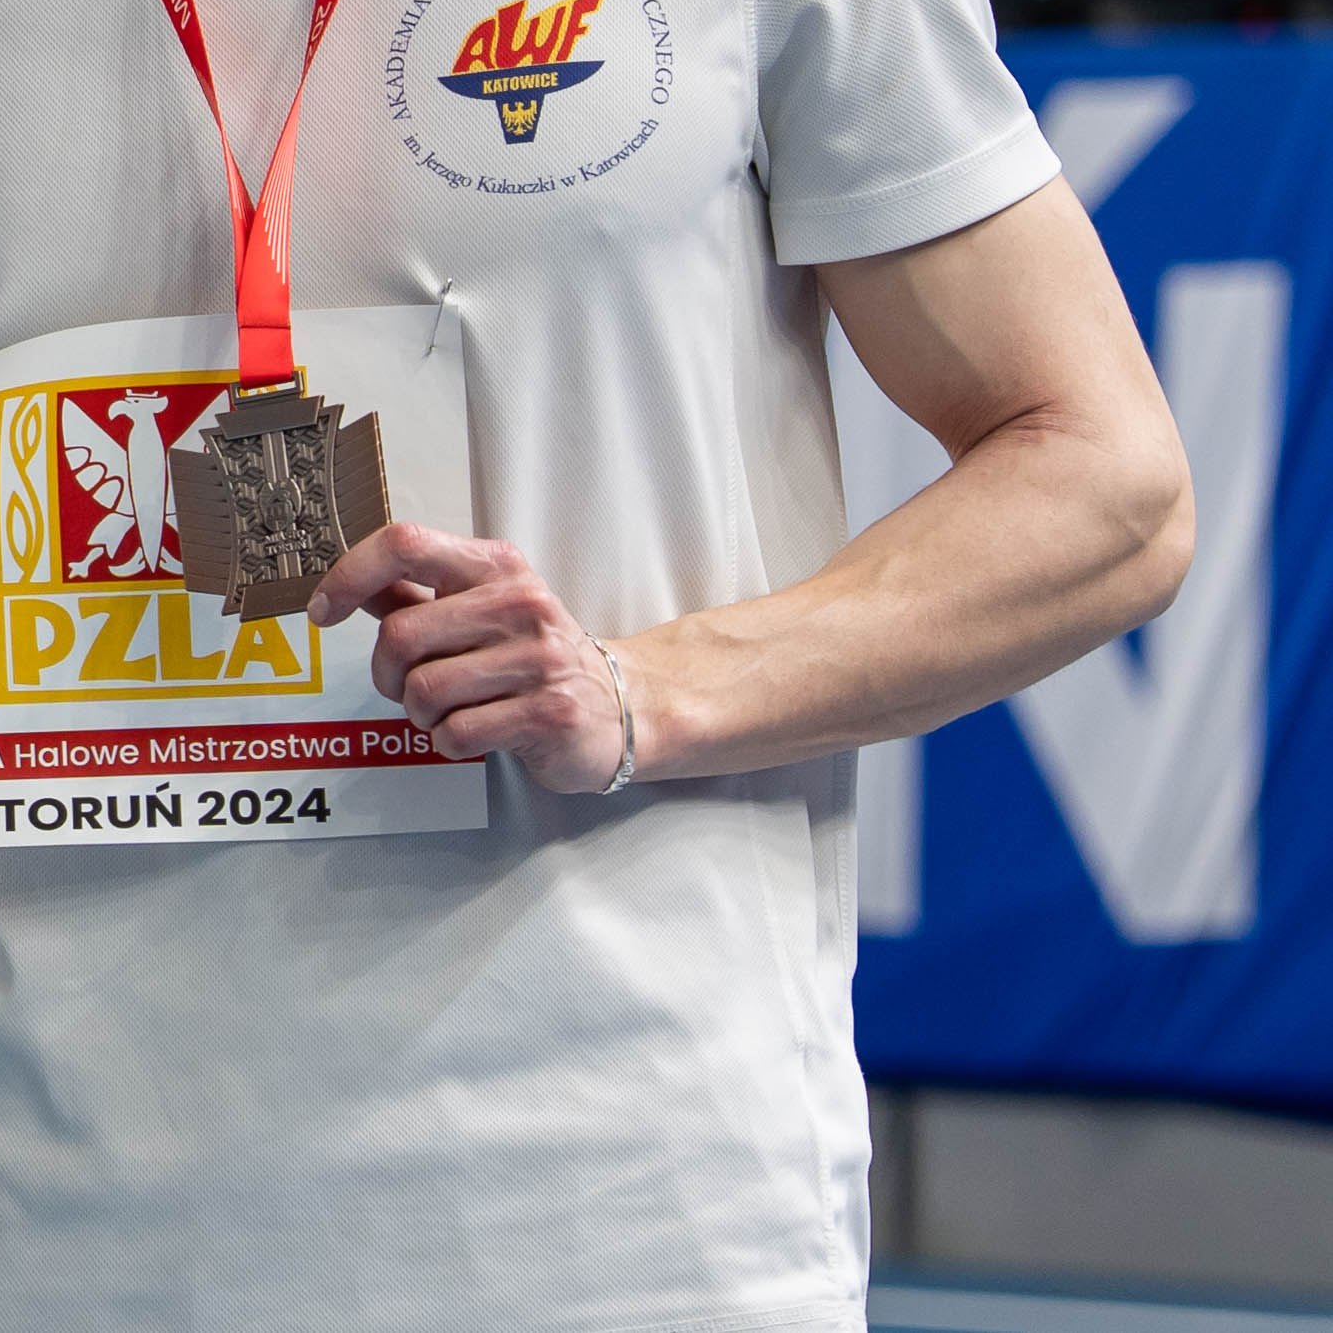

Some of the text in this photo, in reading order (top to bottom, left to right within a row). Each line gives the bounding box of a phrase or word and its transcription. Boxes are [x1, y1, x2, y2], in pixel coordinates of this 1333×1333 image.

[483, 71, 559, 95] KATOWICE
[403, 118, 660, 195] im. Jerzego Kukuczki w Katowicach
[9, 592, 303, 686] PZLA
[14, 740, 140, 768] Halowe
[149, 734, 352, 765] Mistrzostwa
[362, 727, 439, 756] Pols
[197, 787, 331, 827] 2024
